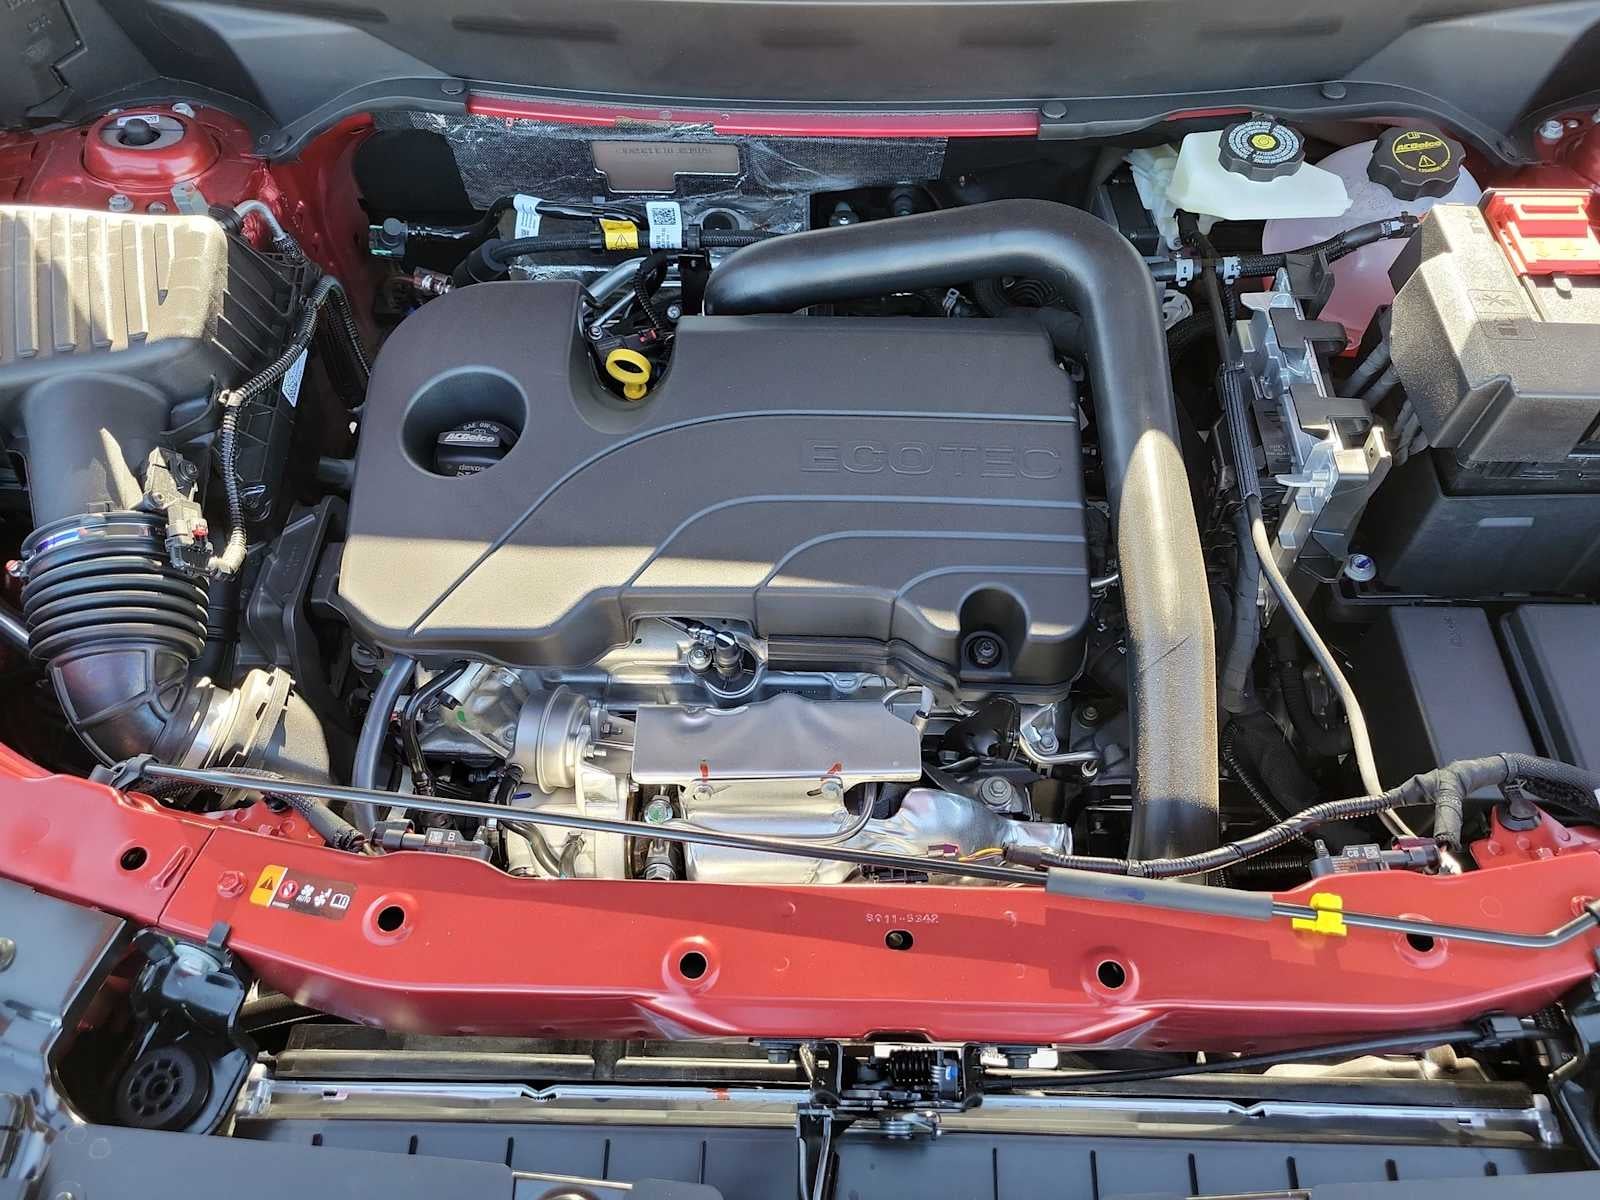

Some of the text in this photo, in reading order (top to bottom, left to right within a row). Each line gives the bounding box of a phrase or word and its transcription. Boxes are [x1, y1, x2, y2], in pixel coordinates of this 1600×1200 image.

[1395, 140, 1442, 153] ACDelco
[444, 433, 496, 443] ACDelco
[800, 440, 1062, 480] ECOTEC
